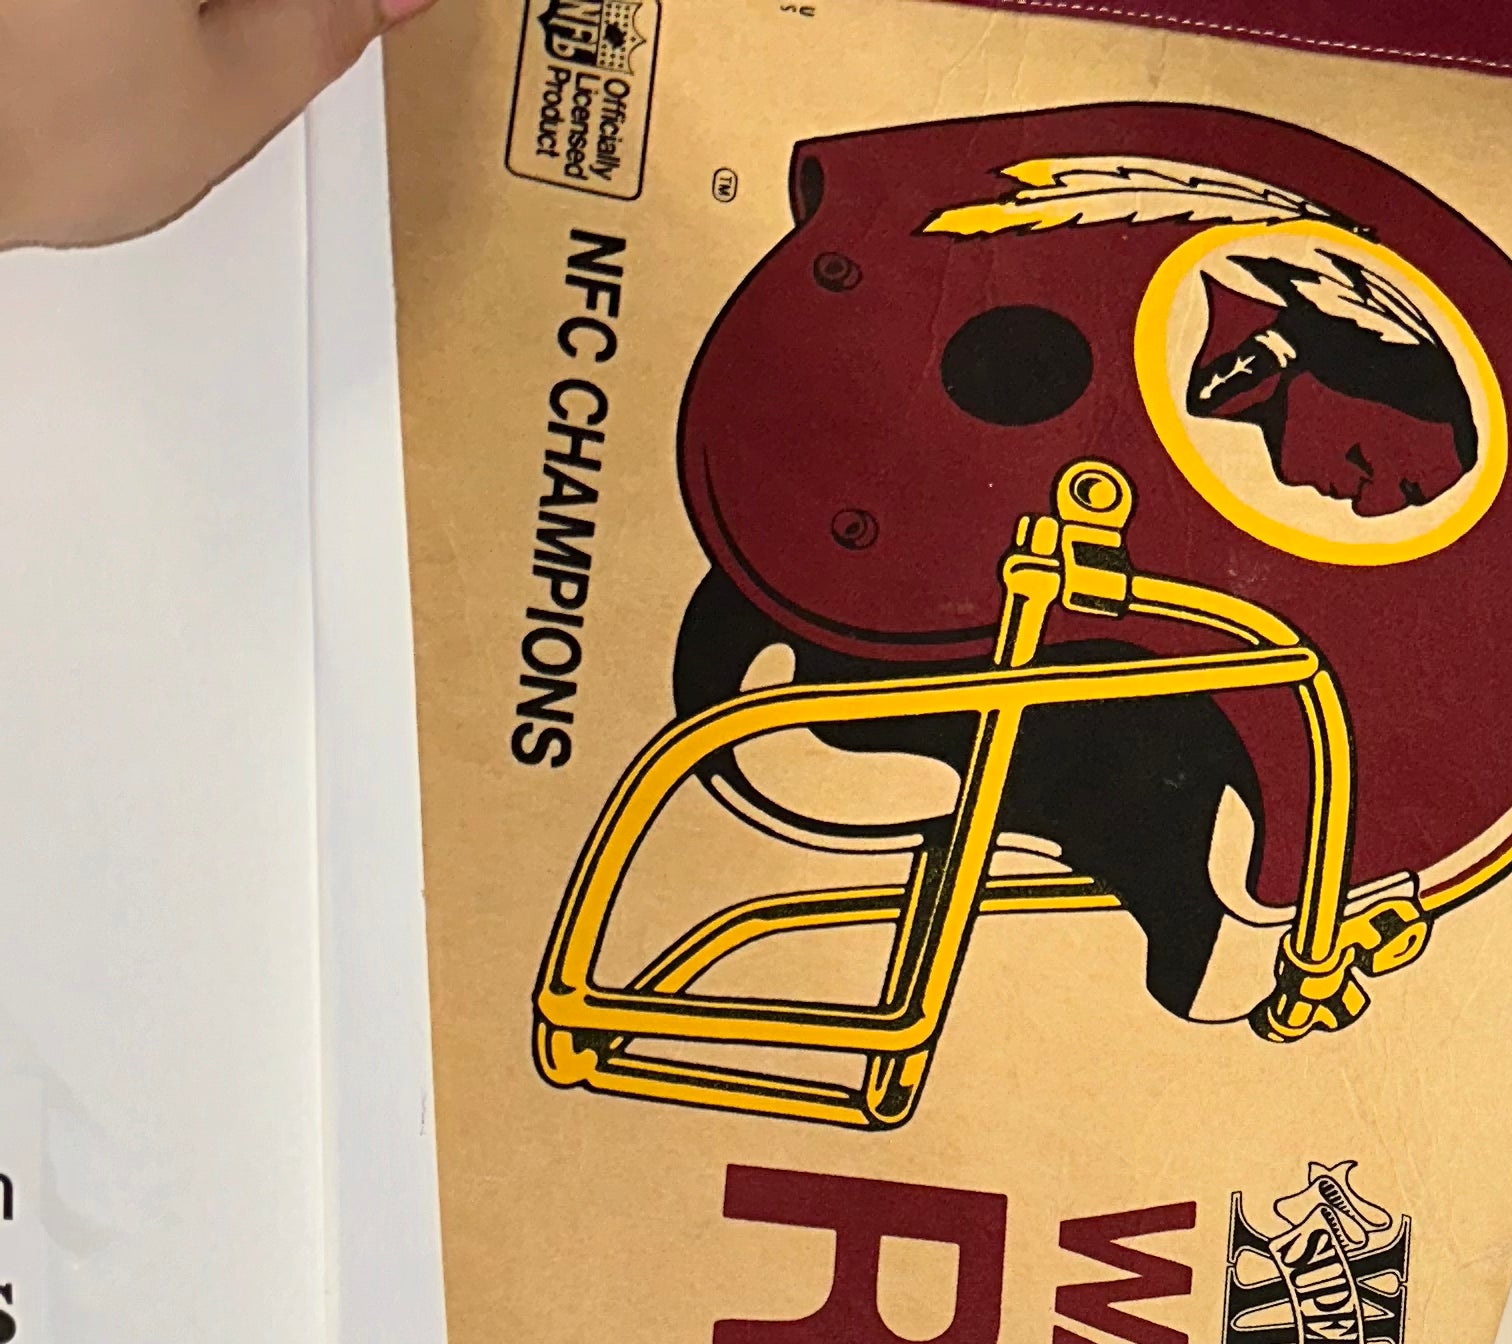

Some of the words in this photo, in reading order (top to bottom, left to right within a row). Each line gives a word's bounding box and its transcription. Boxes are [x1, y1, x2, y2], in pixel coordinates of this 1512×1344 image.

[536, 65, 571, 158] Product
[564, 72, 601, 181] Licensed
[590, 78, 631, 182] Officially
[716, 173, 735, 200] TM
[557, 229, 627, 363] NFC
[511, 378, 608, 768] CHAMPIONS
